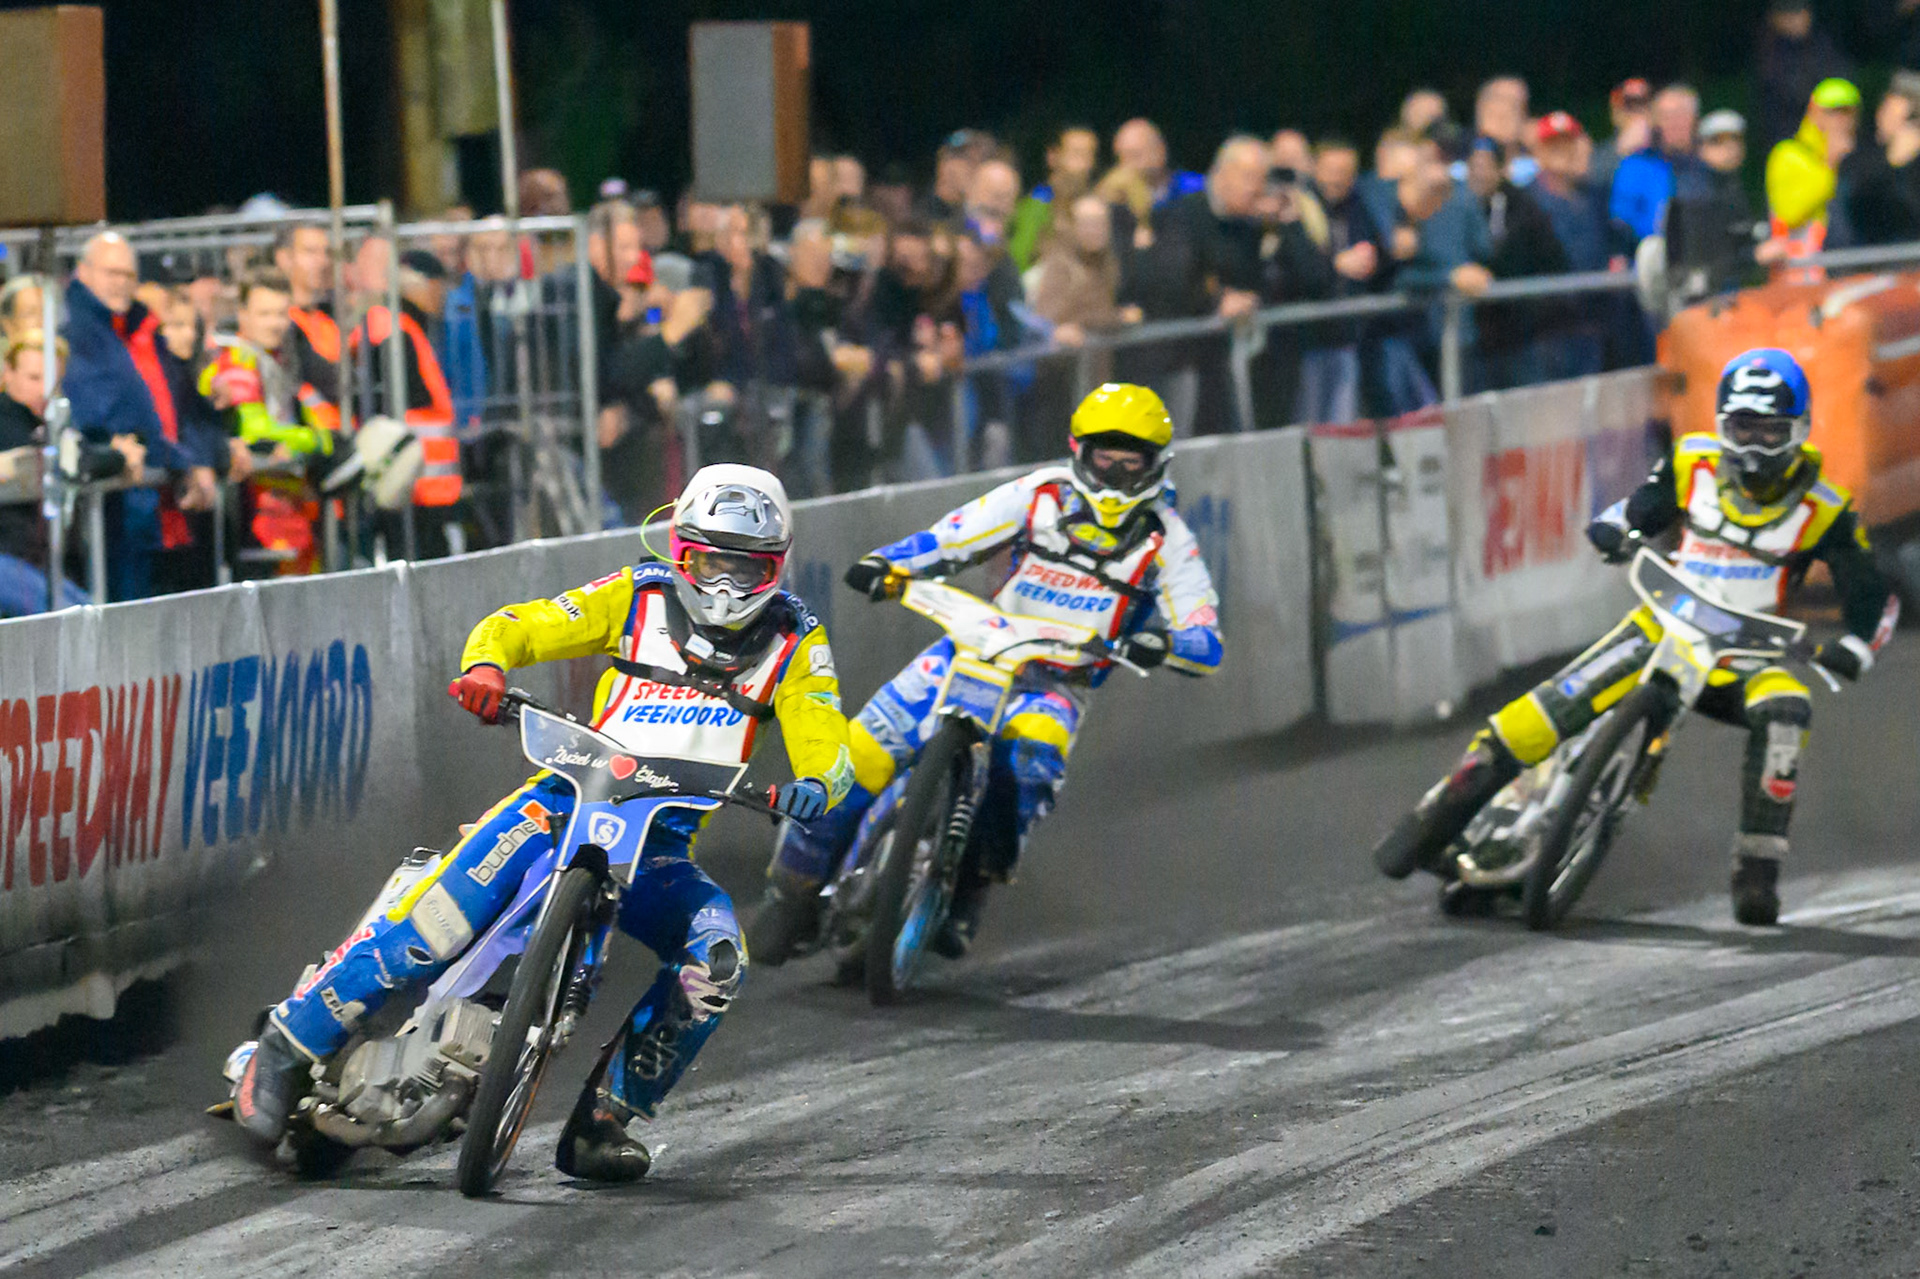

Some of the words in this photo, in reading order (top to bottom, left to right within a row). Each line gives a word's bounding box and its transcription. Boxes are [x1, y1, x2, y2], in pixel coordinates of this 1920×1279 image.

[1014, 580, 1114, 613] VEENOORD
[633, 682, 754, 700] SPEEDY
[621, 704, 745, 728] VEENOORD
